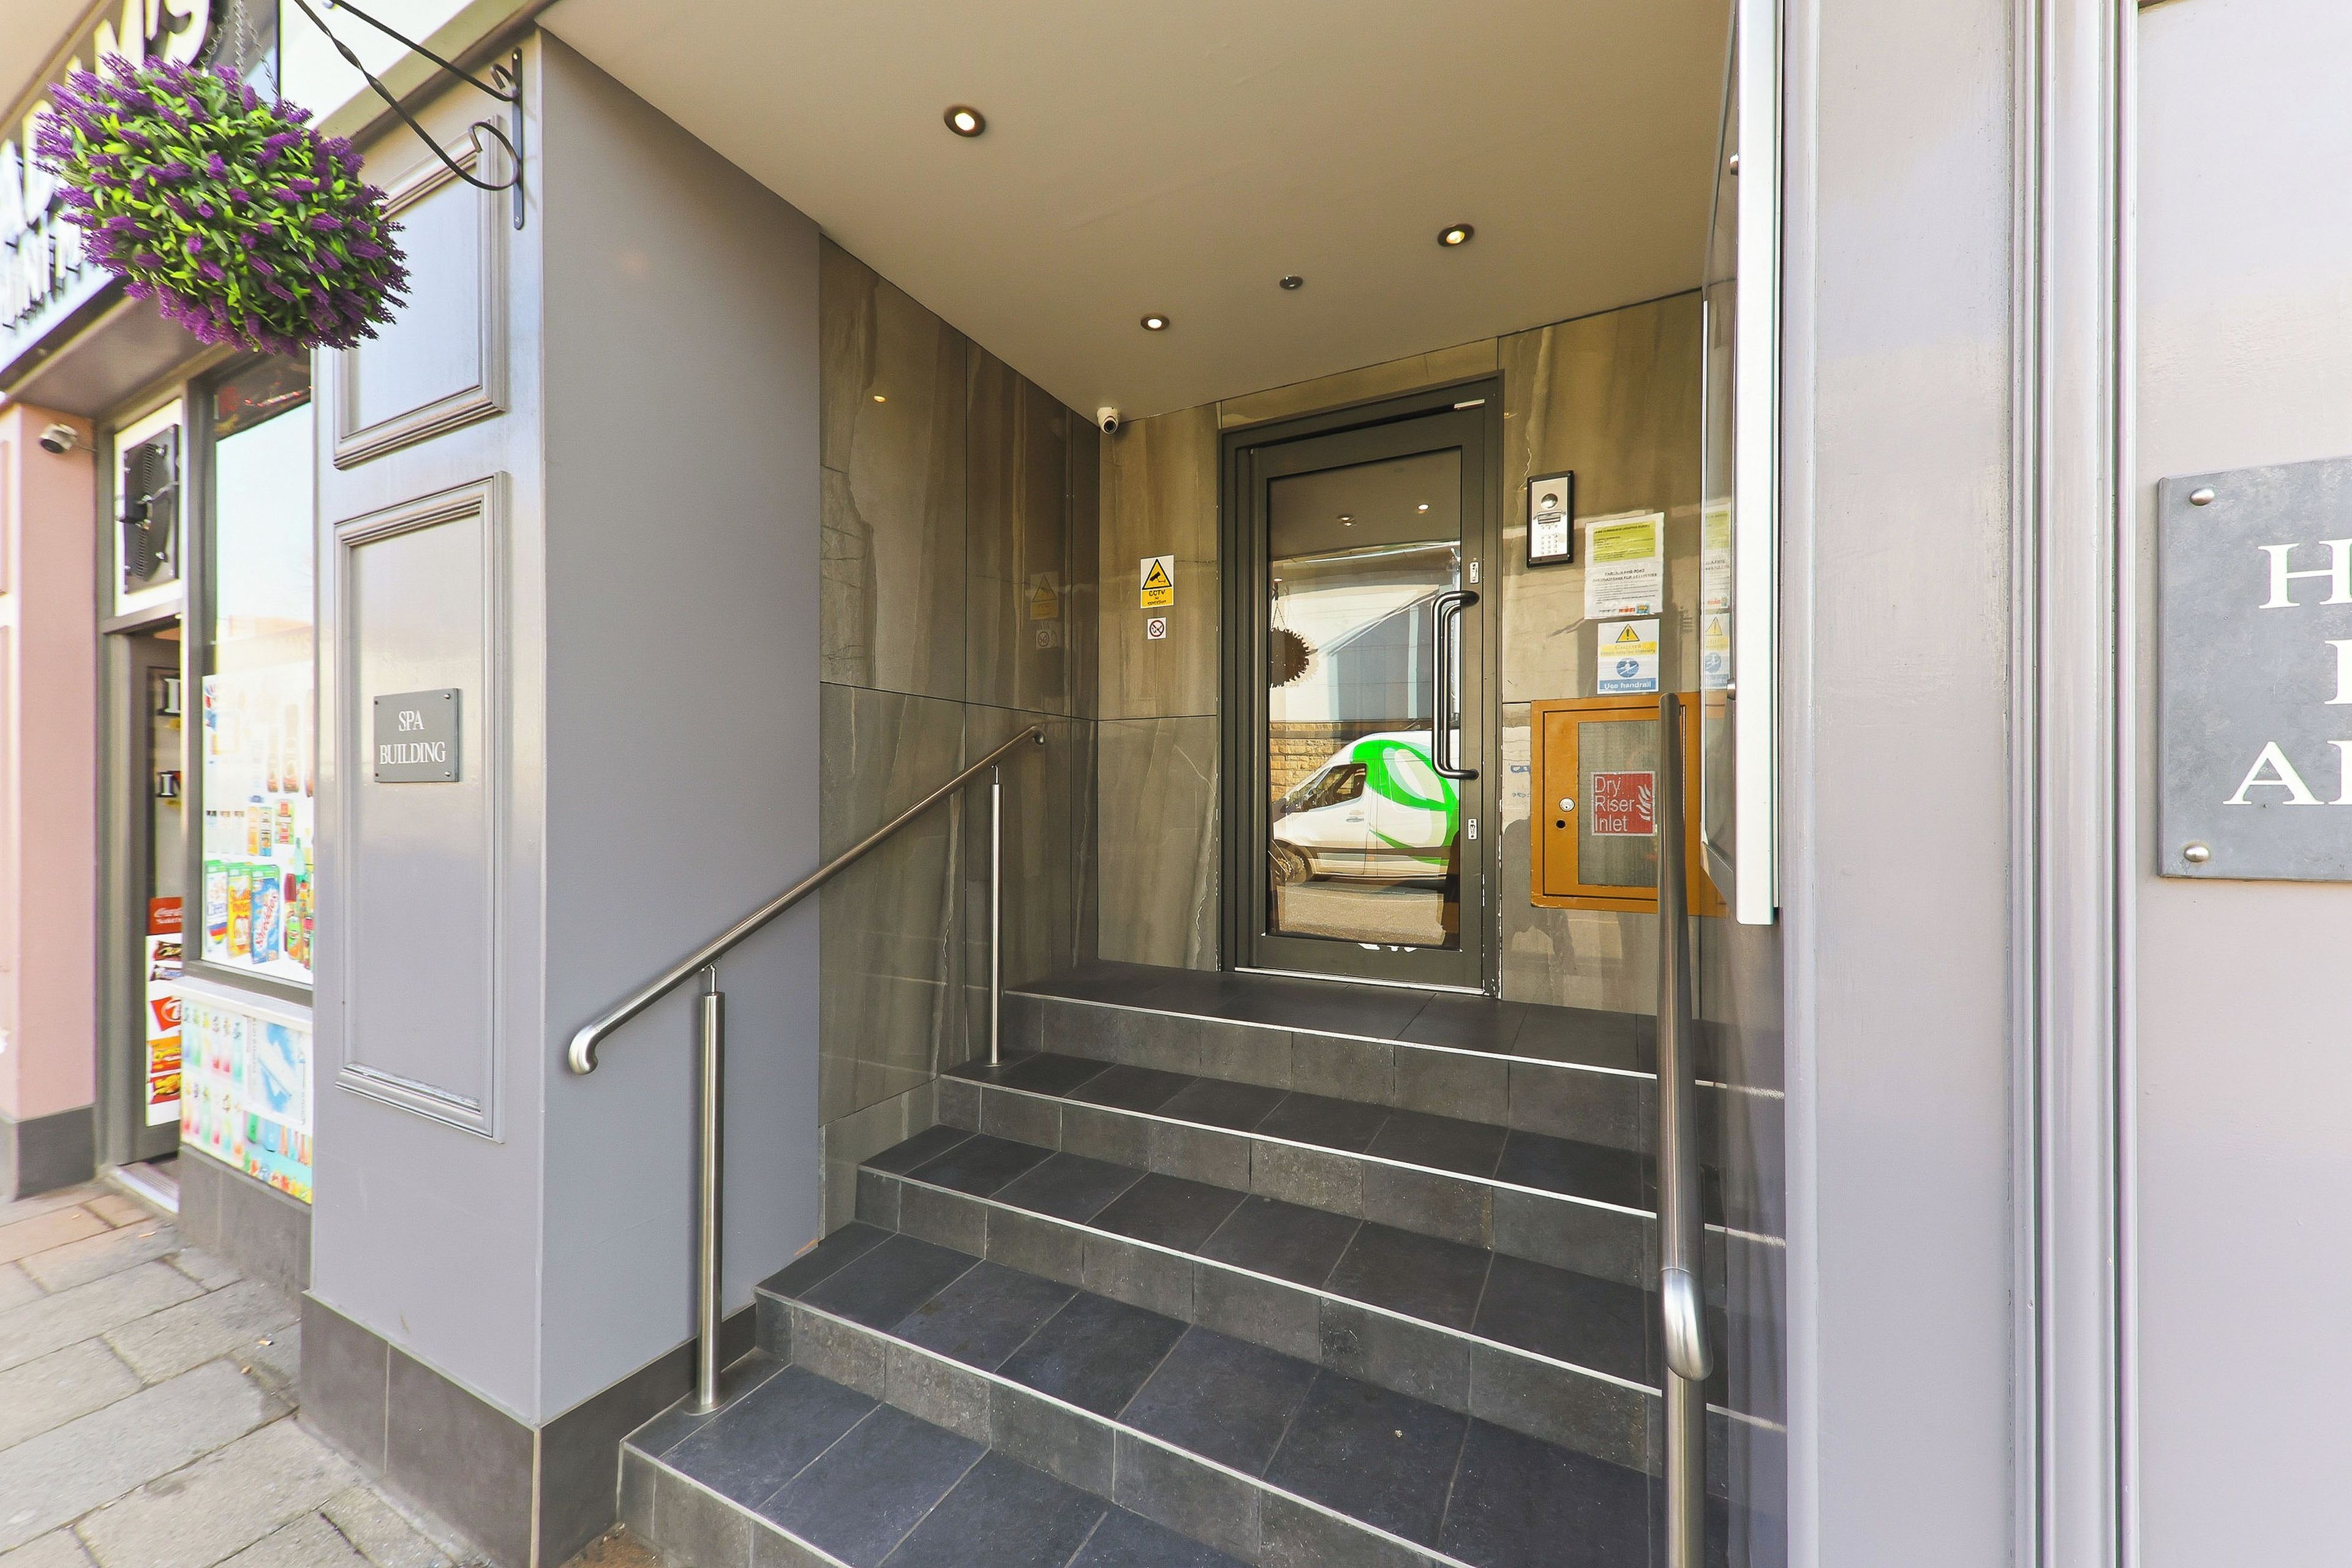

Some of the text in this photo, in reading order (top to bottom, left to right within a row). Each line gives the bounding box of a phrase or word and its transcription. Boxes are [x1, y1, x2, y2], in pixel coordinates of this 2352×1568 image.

[398, 710, 425, 731] SPA
[379, 741, 447, 765] BUILDING
[1594, 776, 1621, 797] Dry
[1594, 795, 1635, 812] Riser
[1594, 813, 1628, 832] Inlet
